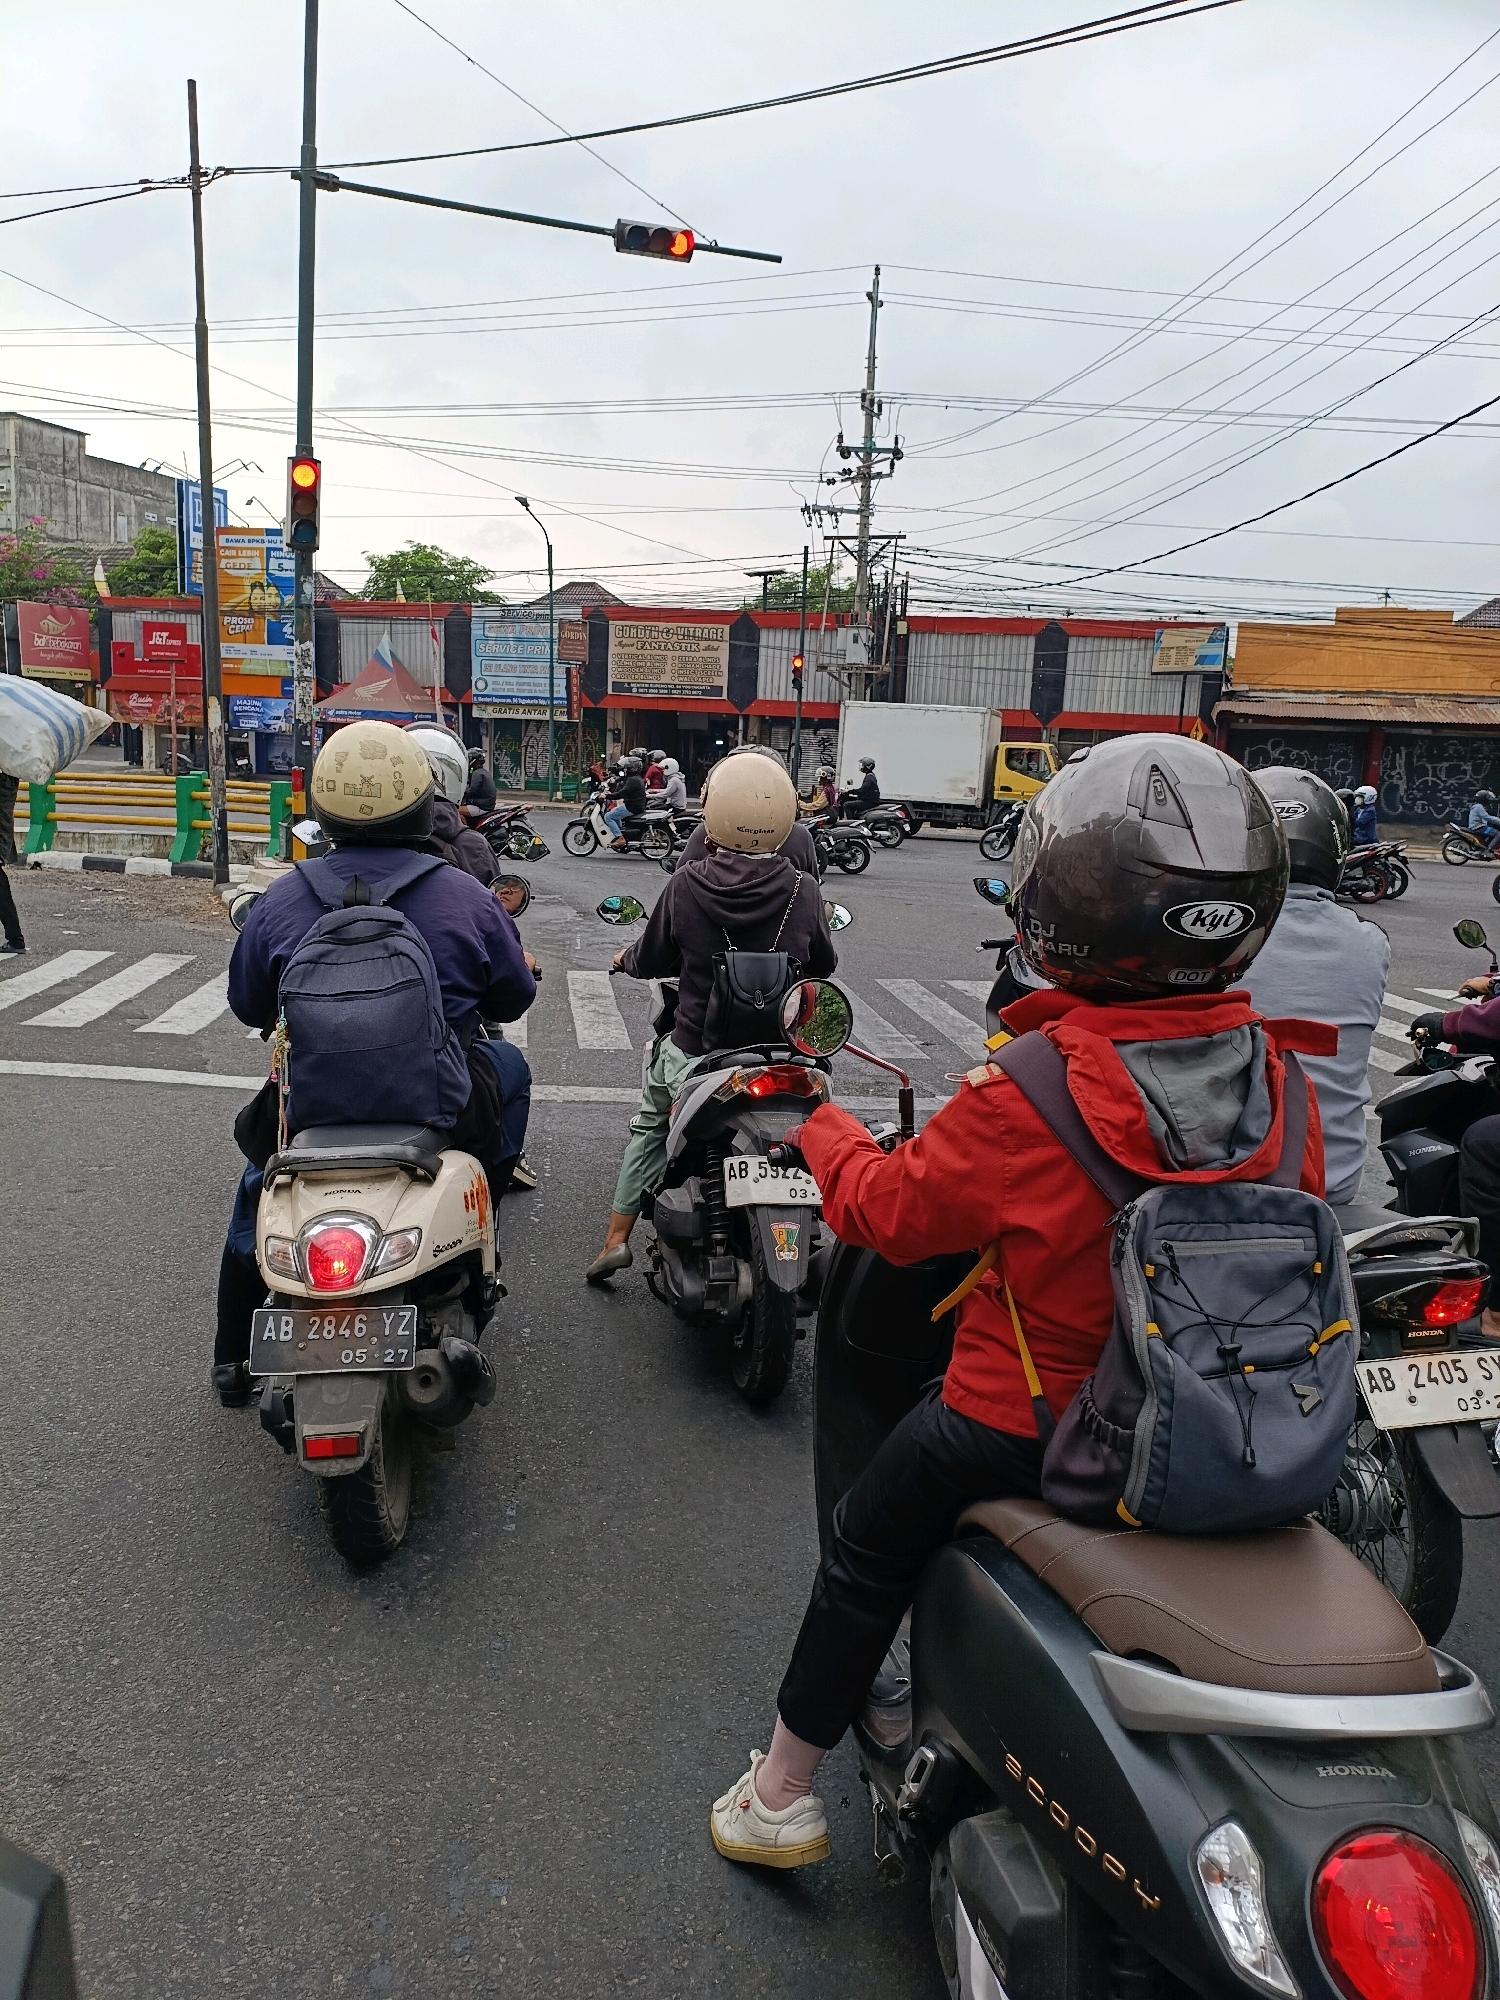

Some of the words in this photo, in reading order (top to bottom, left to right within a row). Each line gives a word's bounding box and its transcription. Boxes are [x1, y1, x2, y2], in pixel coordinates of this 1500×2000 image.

[219, 549, 237, 557] CAIR
[238, 549, 260, 557] LEBIH
[225, 562, 253, 570] GEDE
[500, 608, 534, 619] Service
[488, 624, 516, 635] SEWA
[520, 625, 553, 636] PRINT
[560, 630, 587, 640] GORDYN
[615, 624, 659, 639] GORDYN
[662, 626, 674, 640] &
[676, 625, 724, 642] VITRAGE
[149, 631, 169, 645] J&T
[479, 643, 524, 654] SERVICE
[636, 640, 700, 652] FANTASTIK
[617, 653, 646, 661] VERTICAL
[678, 655, 698, 663] ZEBRA
[483, 663, 492, 673] ISI
[494, 664, 517, 674] ULANG
[646, 660, 668, 668] BLINDS
[617, 666, 645, 674] WOODEN
[645, 667, 666, 675] BLINDS
[677, 669, 699, 677] INSECT
[699, 669, 724, 678] SCREEN
[640, 673, 661, 681] BLINDS
[677, 675, 715, 683] WALLPAPER
[233, 705, 264, 713] RENCANA
[492, 707, 520, 715] GRATIS
[521, 708, 548, 716] ANTAR
[1189, 908, 1238, 932] Kyt
[1029, 917, 1056, 938] DJ
[1030, 936, 1090, 958] MARU
[1174, 969, 1212, 983] DOT
[1408, 1144, 1443, 1157] HONDA
[728, 1160, 749, 1181] AB
[323, 1188, 363, 1198] HONDA
[262, 1314, 294, 1342] AB
[307, 1313, 368, 1340] 2846
[382, 1310, 410, 1337] YZ
[1407, 1329, 1445, 1338] HONDA
[1366, 1367, 1396, 1393] AB
[1407, 1358, 1468, 1389] 2405
[1314, 1764, 1397, 1779] HONDA
[1005, 1752, 1161, 1910] SCOOPY
